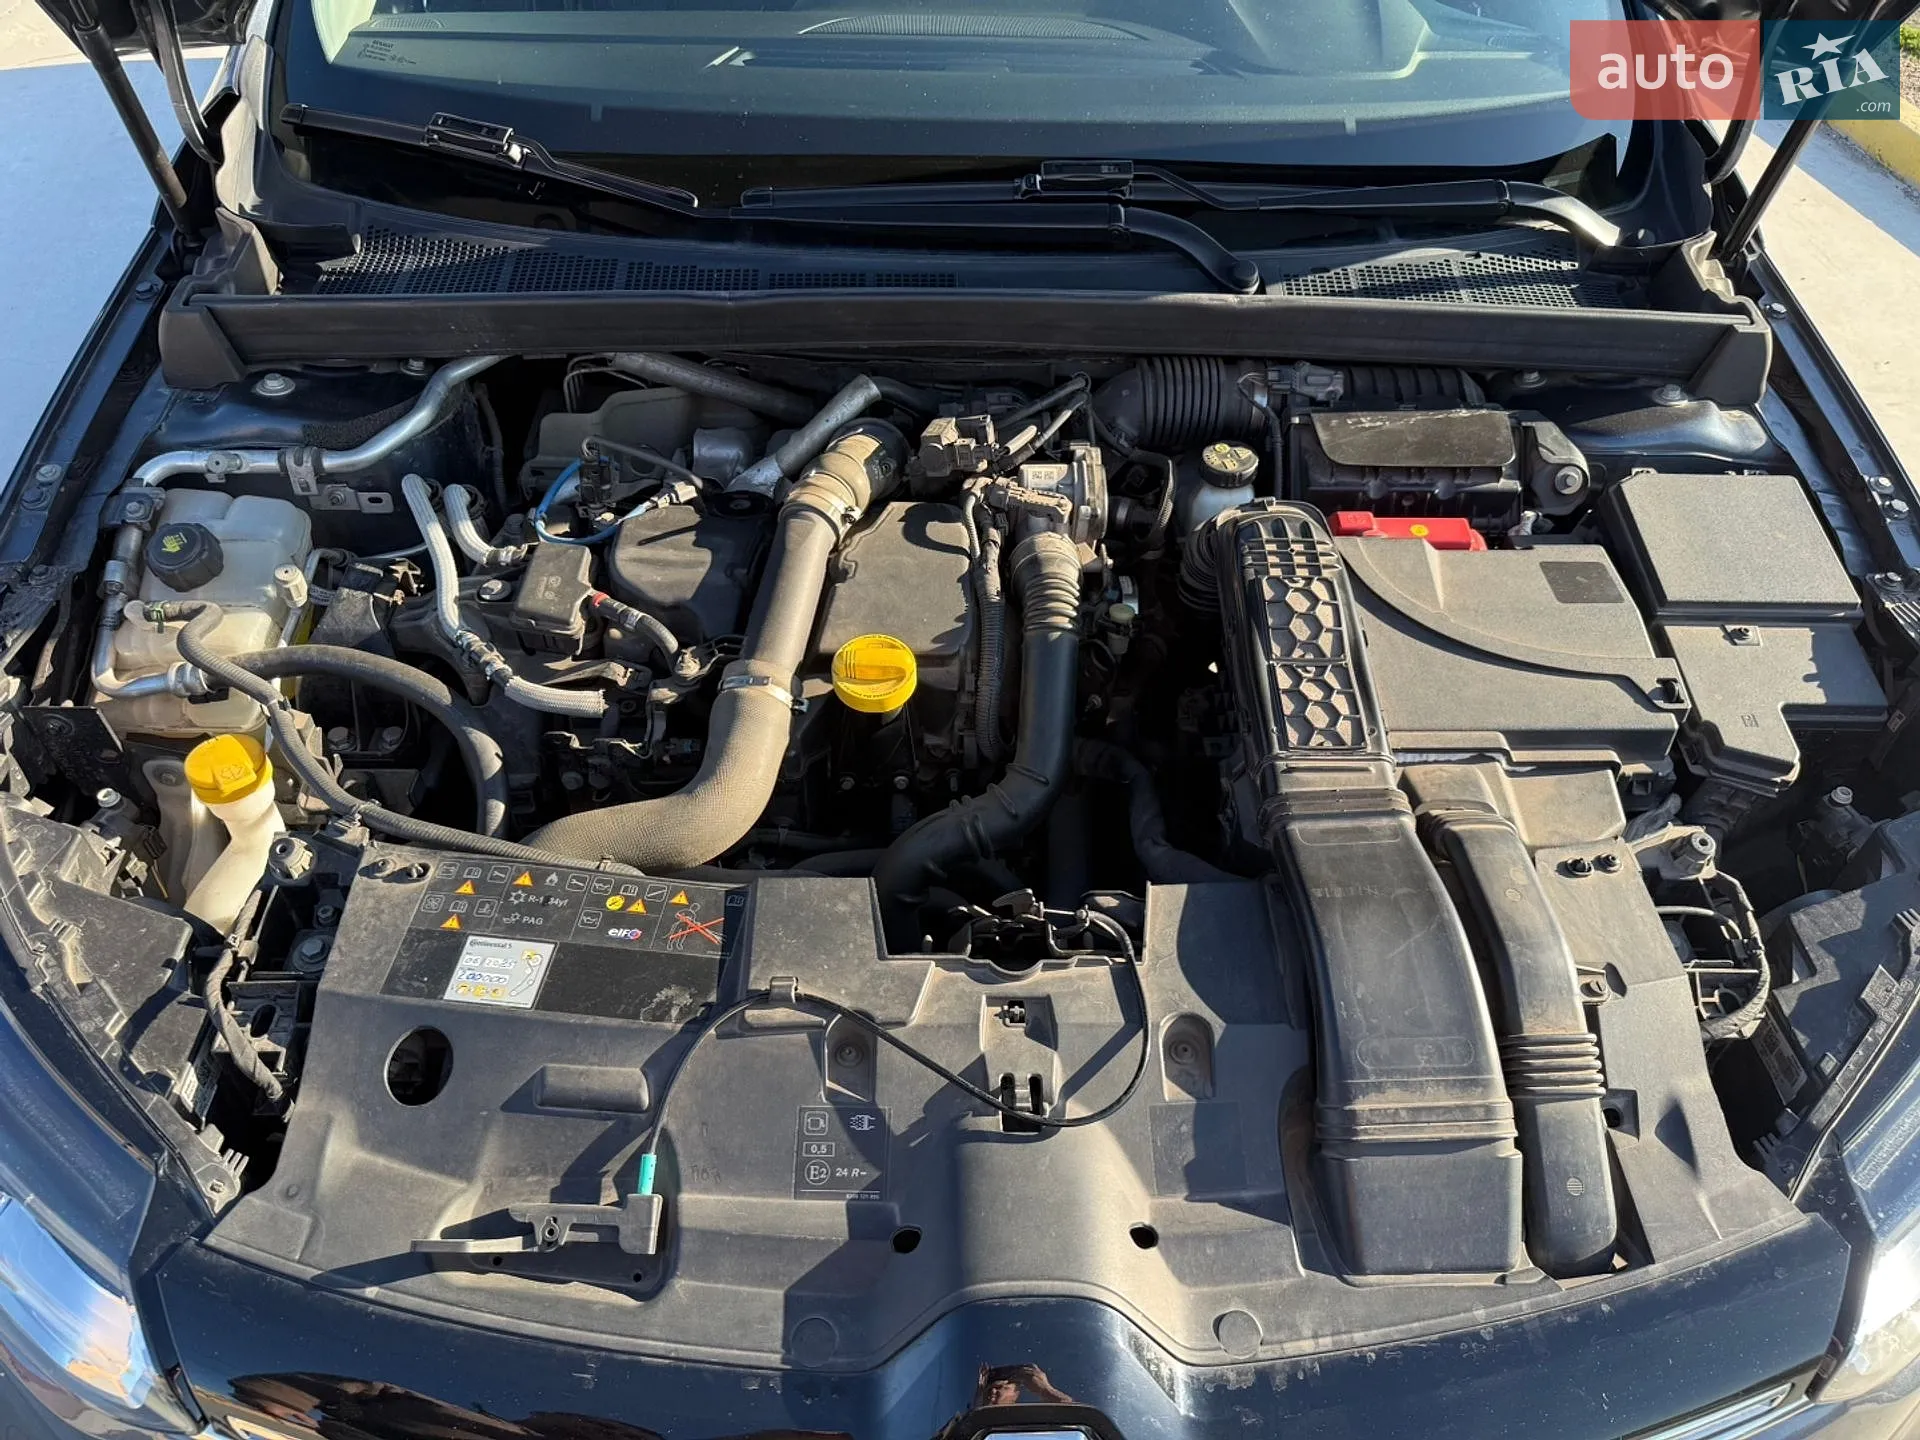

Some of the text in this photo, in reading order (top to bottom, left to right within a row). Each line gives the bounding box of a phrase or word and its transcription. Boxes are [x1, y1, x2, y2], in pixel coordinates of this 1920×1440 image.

[521, 915, 544, 926] PAG
[809, 1165, 827, 1180] E2
[835, 1167, 848, 1177] 24
